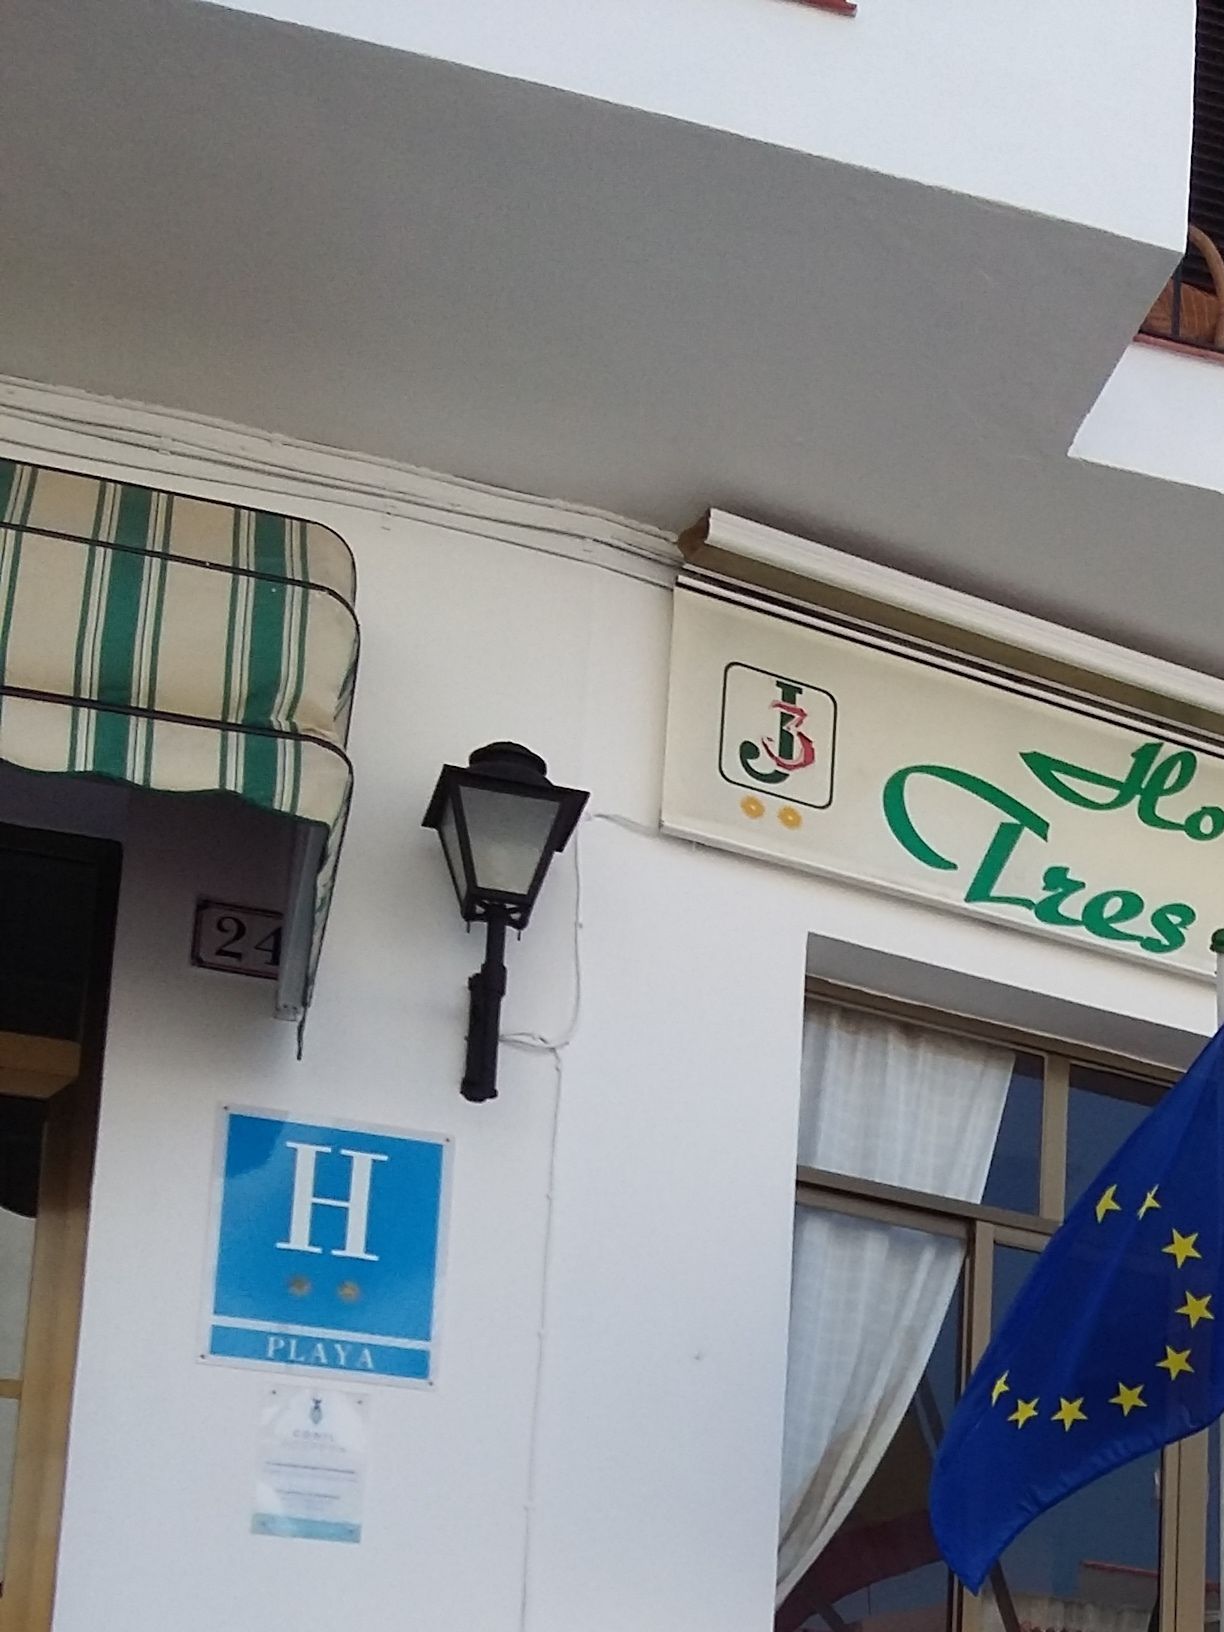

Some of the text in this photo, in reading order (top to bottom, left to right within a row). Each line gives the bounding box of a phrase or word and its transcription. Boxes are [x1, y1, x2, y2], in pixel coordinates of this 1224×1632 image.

[883, 764, 1197, 954] Tres
[215, 915, 283, 967] 24
[276, 1140, 389, 1262] H
[265, 1335, 376, 1371] PLAYA
